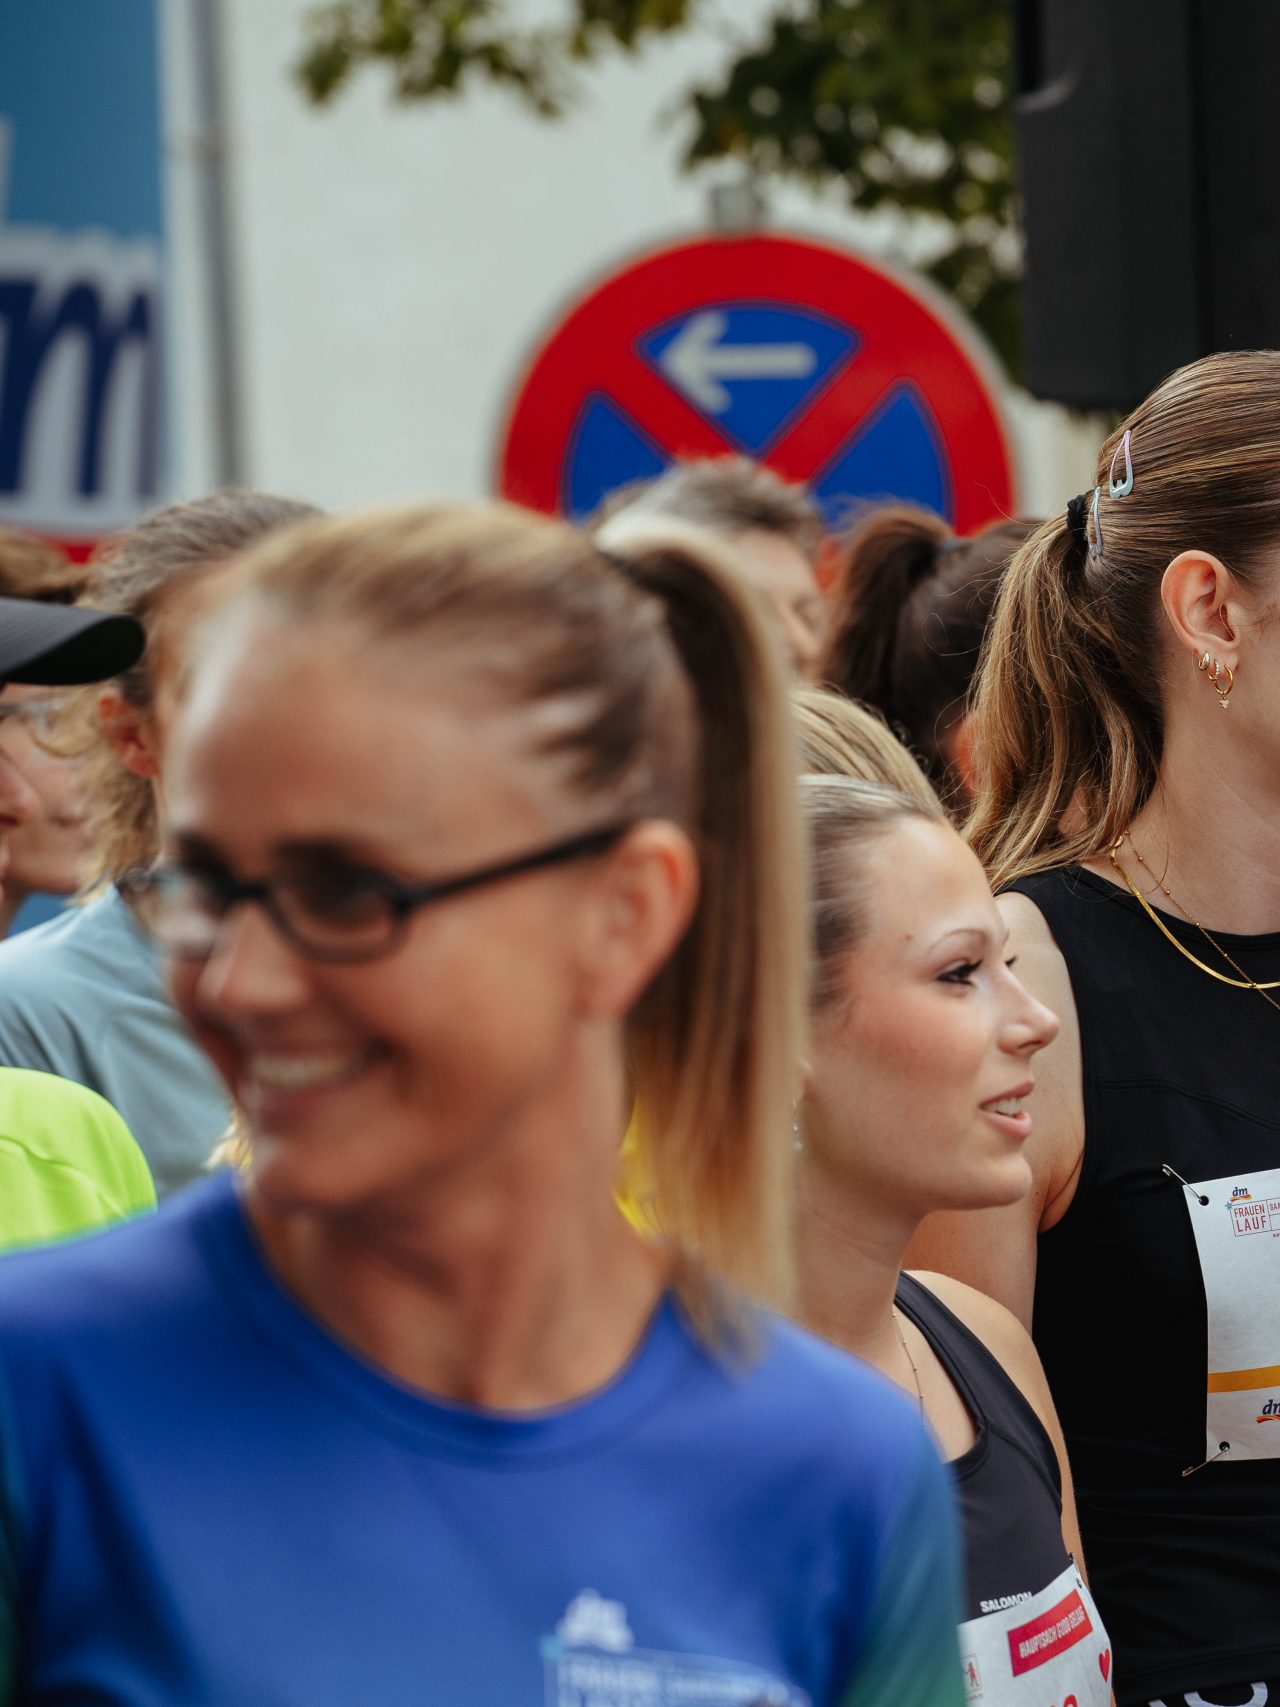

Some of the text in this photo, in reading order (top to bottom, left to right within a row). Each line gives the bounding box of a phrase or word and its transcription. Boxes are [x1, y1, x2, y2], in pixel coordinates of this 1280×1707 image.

[1232, 1186, 1248, 1197] dm
[1233, 1203, 1265, 1218] FRAUEN
[1236, 1215, 1267, 1232] LAUF
